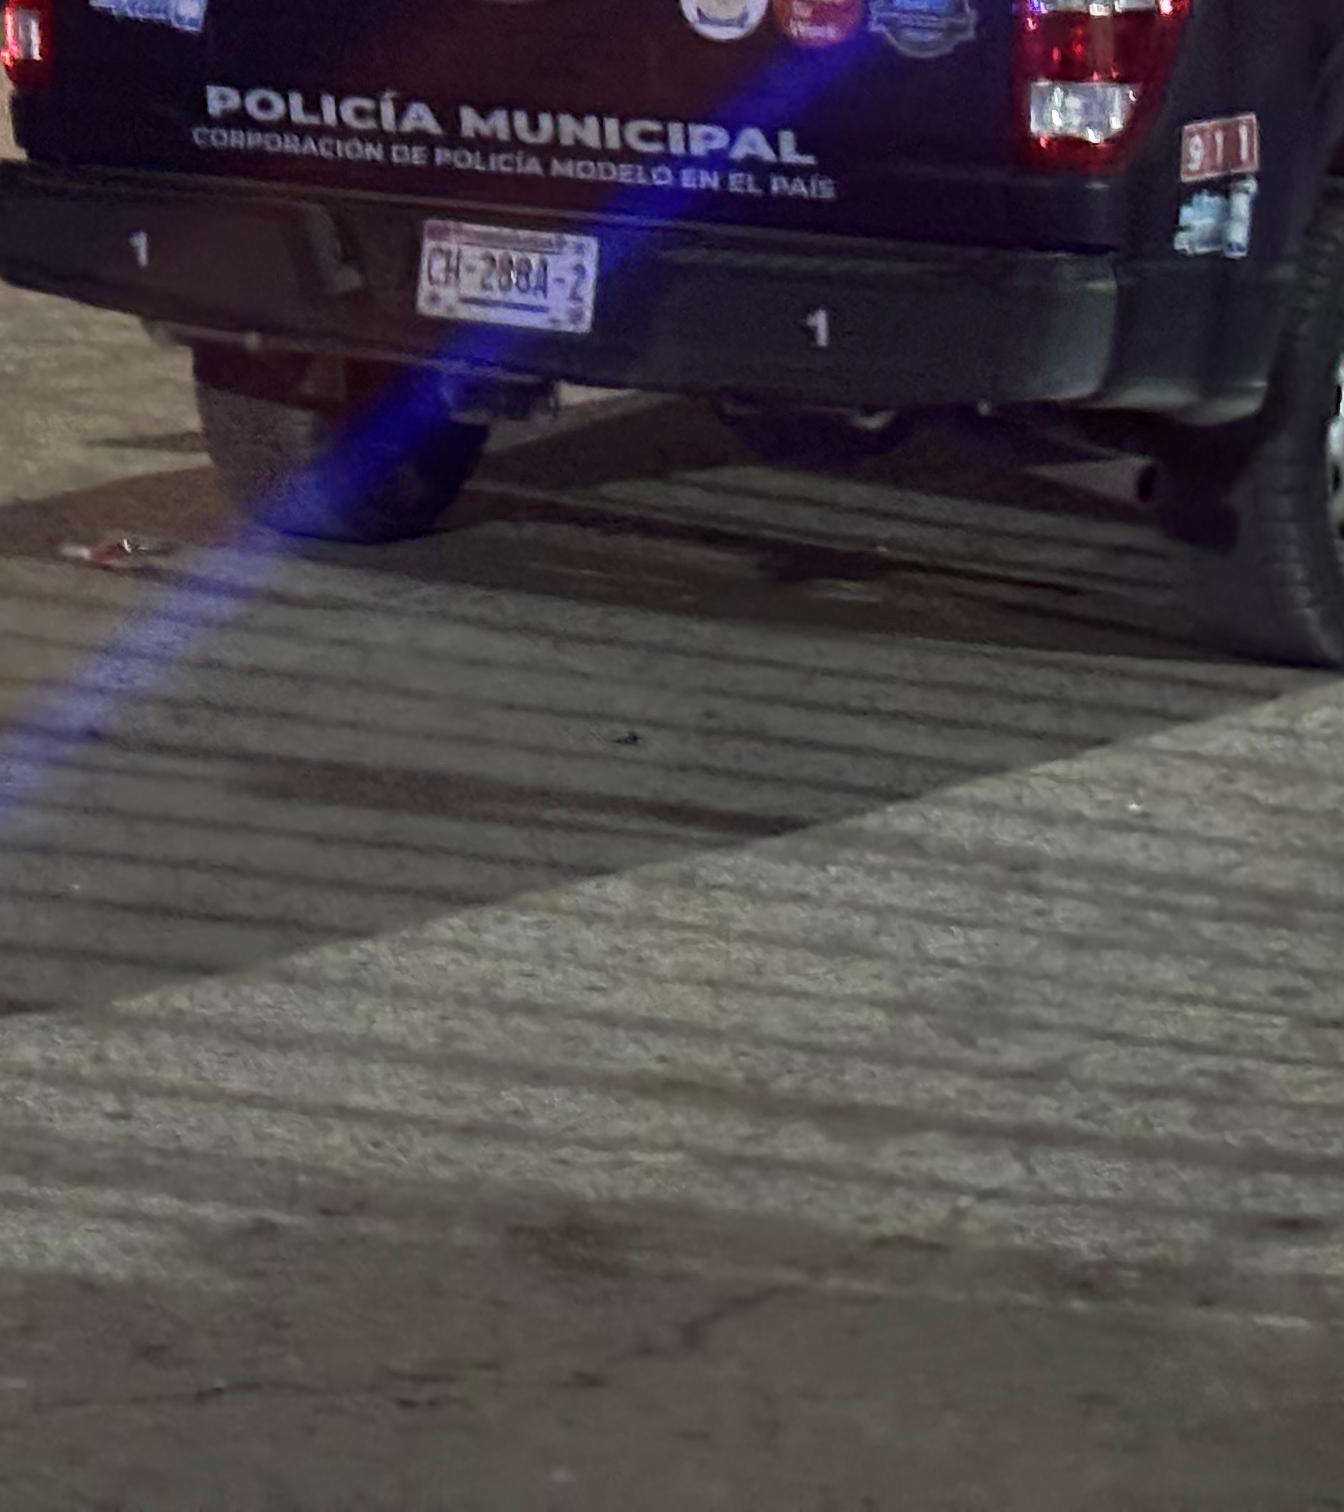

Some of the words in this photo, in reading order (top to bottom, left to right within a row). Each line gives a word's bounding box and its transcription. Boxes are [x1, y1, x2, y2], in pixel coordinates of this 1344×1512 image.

[206, 85, 444, 136] POLICÍA
[460, 104, 816, 165] MUNICIPAL
[1188, 123, 1250, 171] 911
[392, 145, 429, 165] DE
[435, 146, 543, 175] POLICÍA
[550, 157, 673, 186] MODELO
[681, 165, 720, 189] EN
[728, 172, 762, 194] EL
[770, 172, 836, 200] PAÍS
[128, 230, 149, 268] 1
[806, 308, 829, 347] 1
